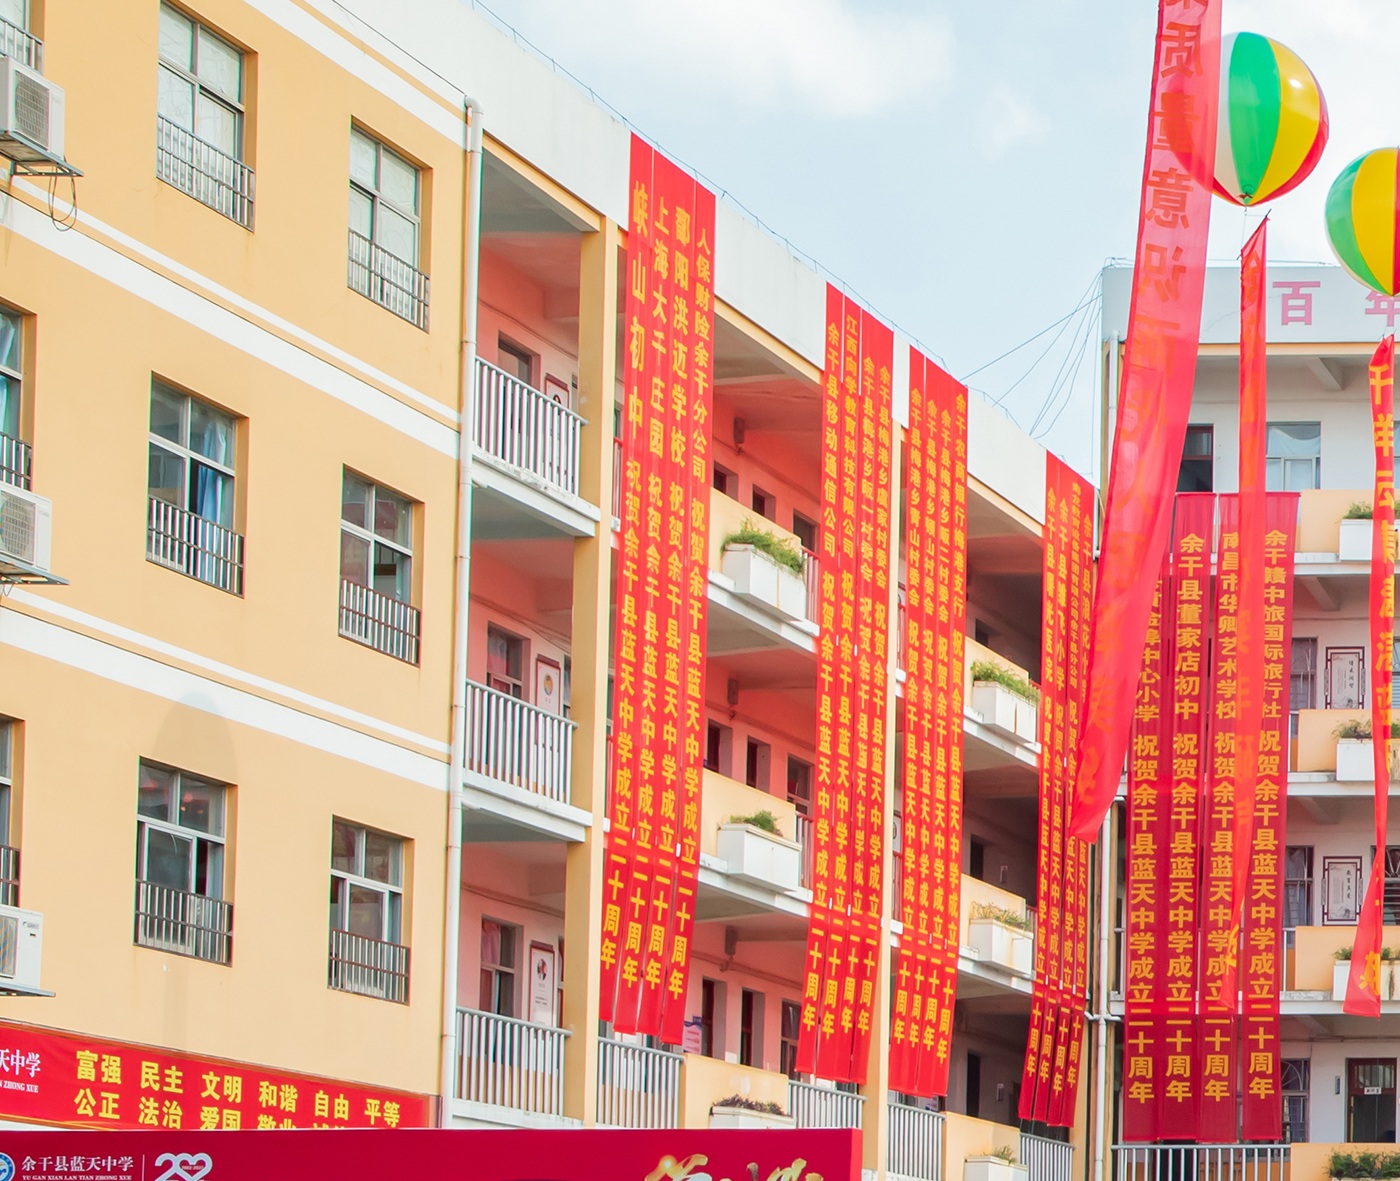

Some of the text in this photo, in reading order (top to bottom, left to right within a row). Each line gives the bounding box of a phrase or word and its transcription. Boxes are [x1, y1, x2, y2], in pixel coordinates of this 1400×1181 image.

[600, 181, 648, 971] 峡山初中 祝贺余干县蓝天中学成立二十周年
[622, 471, 663, 989] 祝贺余干县蓝天中学成立二十周年
[645, 480, 685, 991] 祝贺余干县蓝天中学成立二十周年
[668, 228, 711, 1000] 人保财险余干分公司 祝贺余干县蓝天中学成立二十周年
[803, 322, 840, 1031] 余干县移动通信公司 祝贺余干县蓝天中学成立二十周年
[1262, 529, 1288, 719] 余干赣中旅国际旅行社
[821, 568, 854, 1040] 祝贺余干县蓝天中学成立二十周年
[857, 600, 887, 1038] 祝贺余干县蓝天中学成立二十周年
[893, 617, 919, 1045] 祝贺余干县蓝天中学成立二十周年
[910, 628, 934, 1048] 祝贺余干县蓝天中学成立二十周年
[923, 632, 949, 1052] 祝贺余干县蓝天中学成立二十周年
[936, 628, 963, 1065] 祝贺余干县蓝天中学成立二十周年
[1128, 734, 1159, 1104] 祝贺余干县蓝天中学成立二十周年
[1165, 533, 1205, 1103] 余干县董家店初中 祝贺余干县蓝天中学成立二十周年
[1204, 732, 1236, 1102] 祝贺余干县蓝天中学成立二十周年
[1249, 730, 1282, 1100] 祝贺余干县蓝天中学成立二十周年
[21, 1155, 134, 1173] 余干县蓝天中学
[74, 1088, 120, 1120] 公正
[138, 1097, 183, 1129] 法治
[75, 1050, 400, 1128] 富强 民主 文明 和谐 自由 平等
